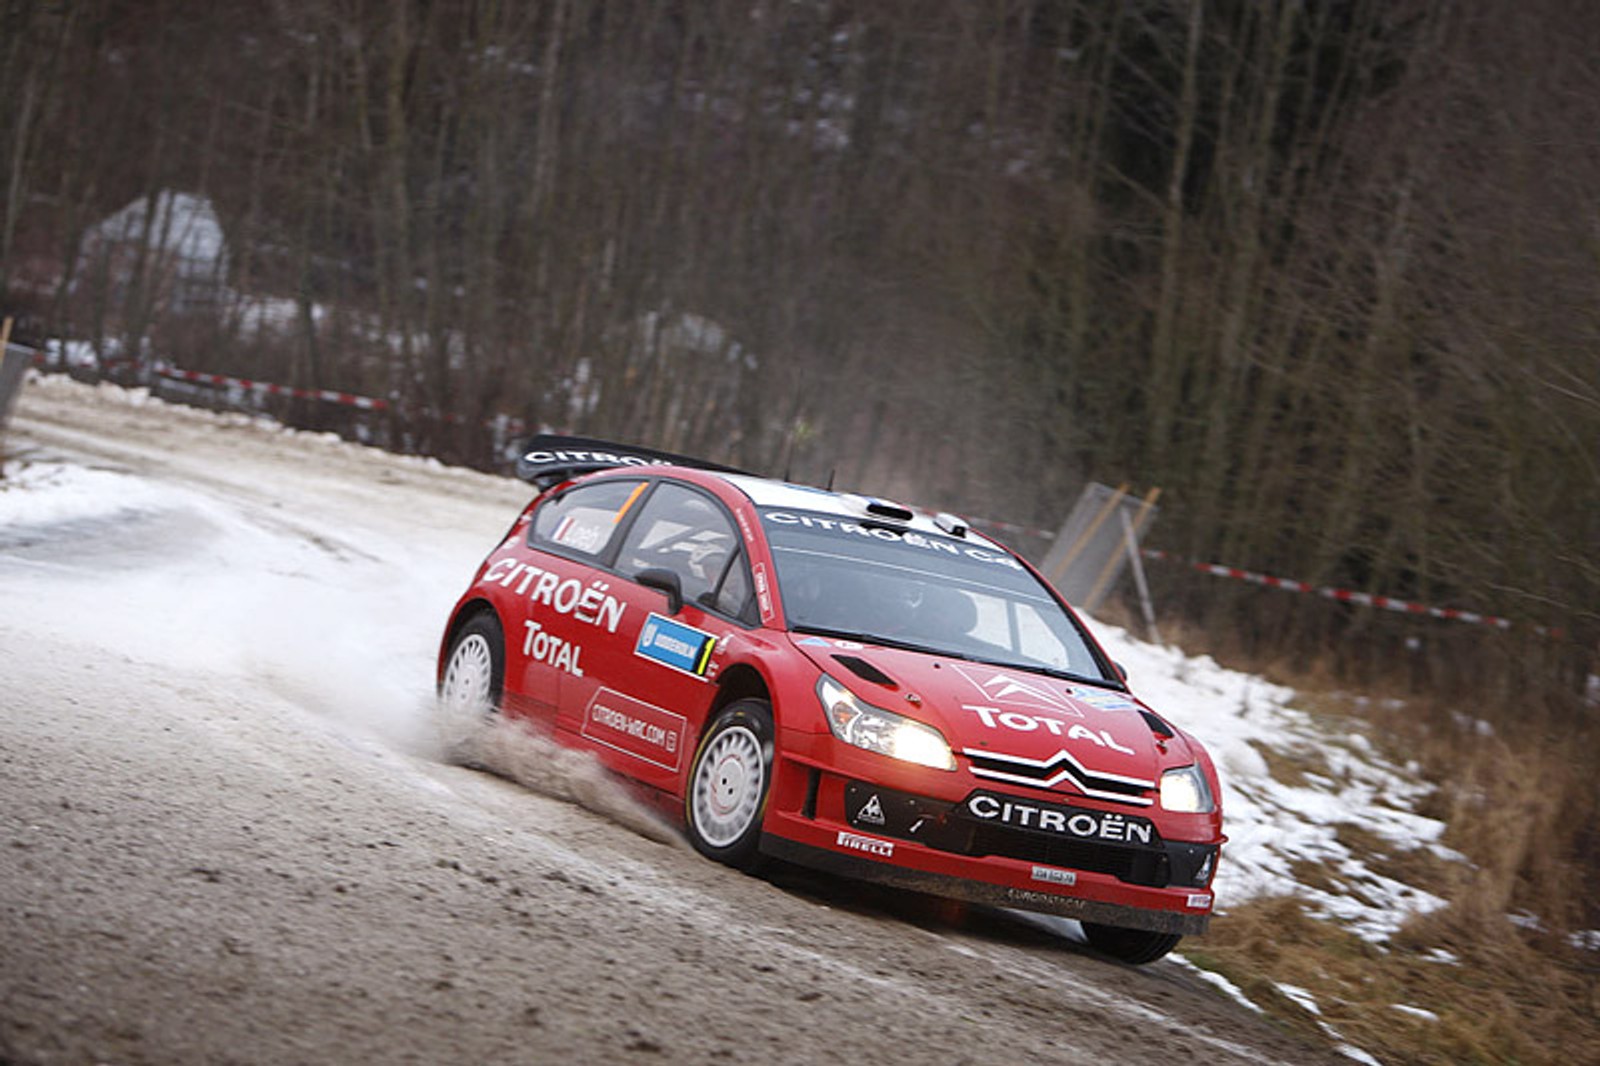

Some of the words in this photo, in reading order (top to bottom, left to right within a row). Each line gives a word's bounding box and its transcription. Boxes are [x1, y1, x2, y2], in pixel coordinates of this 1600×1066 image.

[524, 450, 672, 467] CITRO
[483, 558, 628, 633] CITROËN
[523, 620, 584, 677] TOTAL
[962, 704, 1135, 755] TOTAL
[837, 831, 894, 857] PIRELLI
[967, 795, 1153, 844] CITROËN
